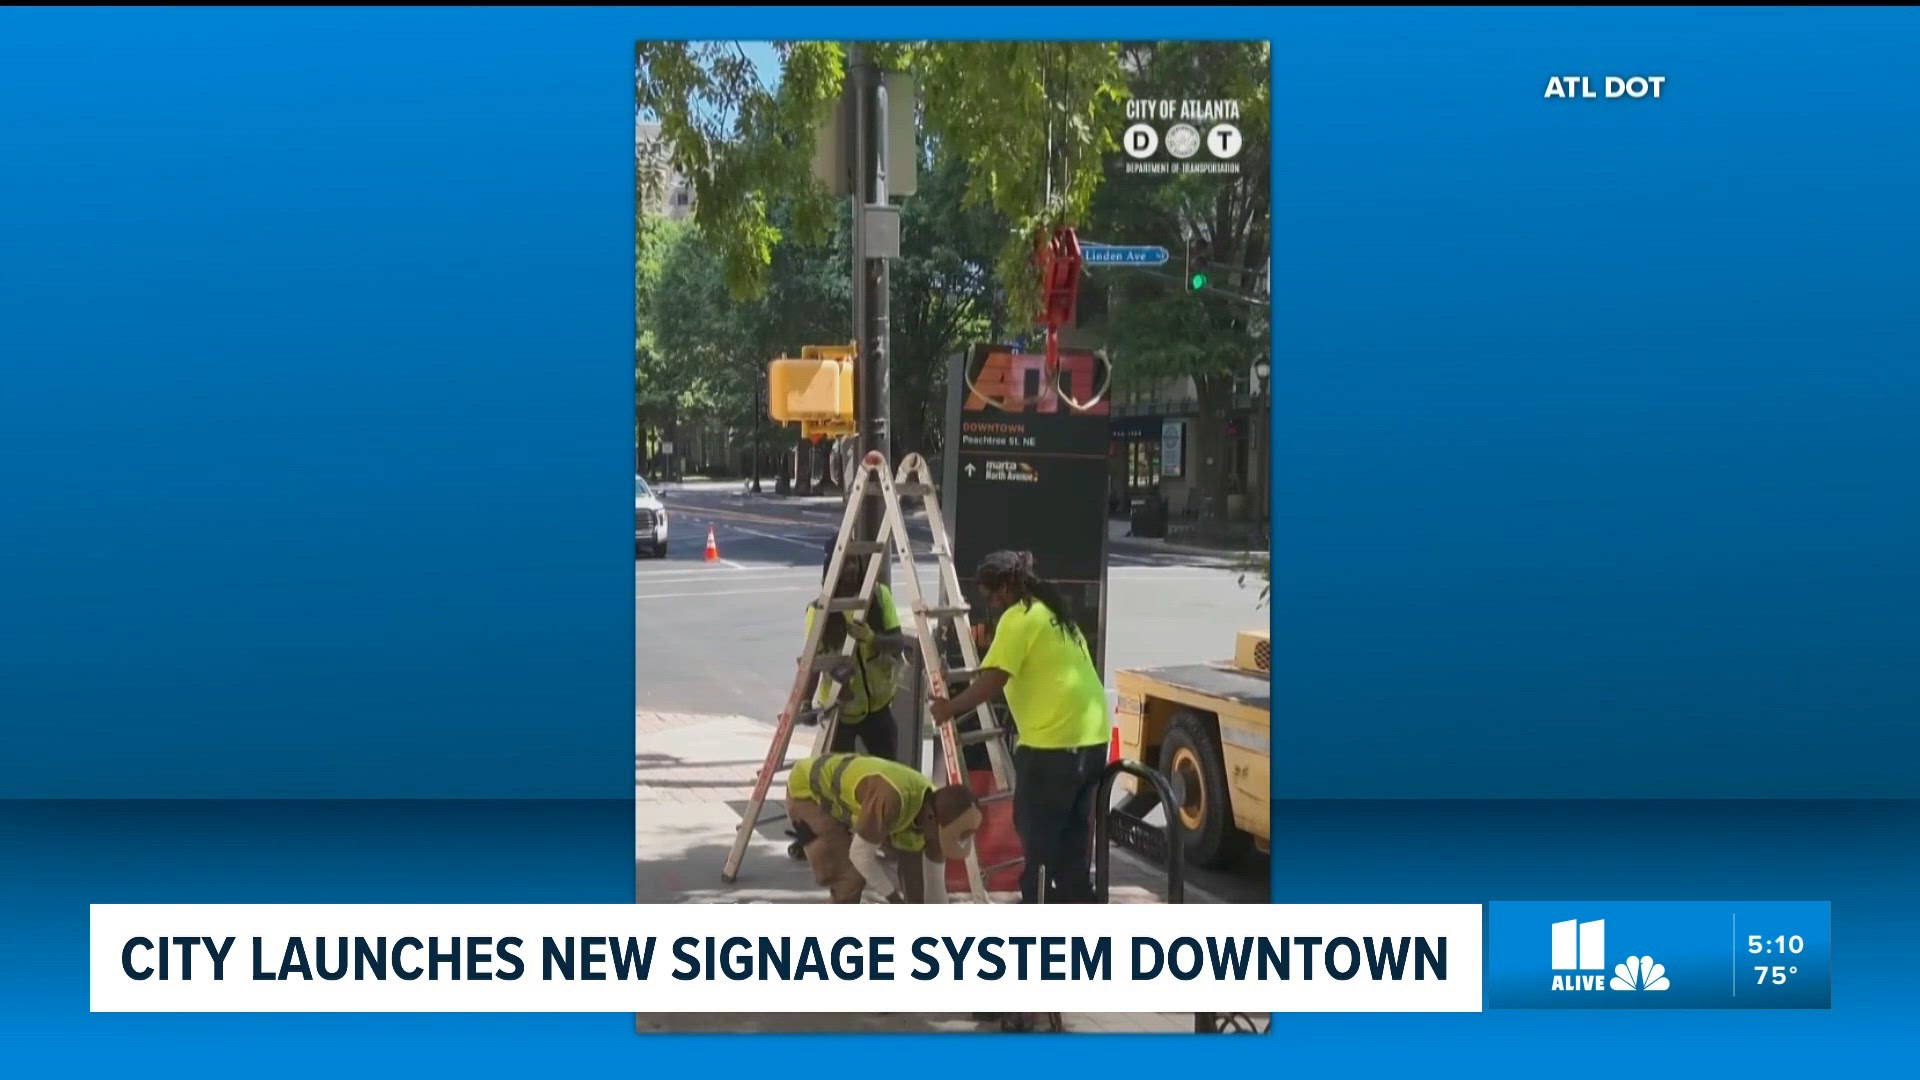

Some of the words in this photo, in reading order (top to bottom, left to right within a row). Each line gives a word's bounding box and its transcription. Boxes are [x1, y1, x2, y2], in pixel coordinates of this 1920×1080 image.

[1086, 250, 1122, 261] Linden
[1127, 250, 1146, 261] Ave
[964, 352, 1109, 416] ATL
[963, 422, 1025, 434] DOWNTOWN
[962, 435, 1007, 446] Peachtree
[1023, 437, 1036, 447] NE
[986, 461, 1017, 470] marta
[985, 471, 1006, 481] North
[1007, 472, 1033, 482] Avenue
